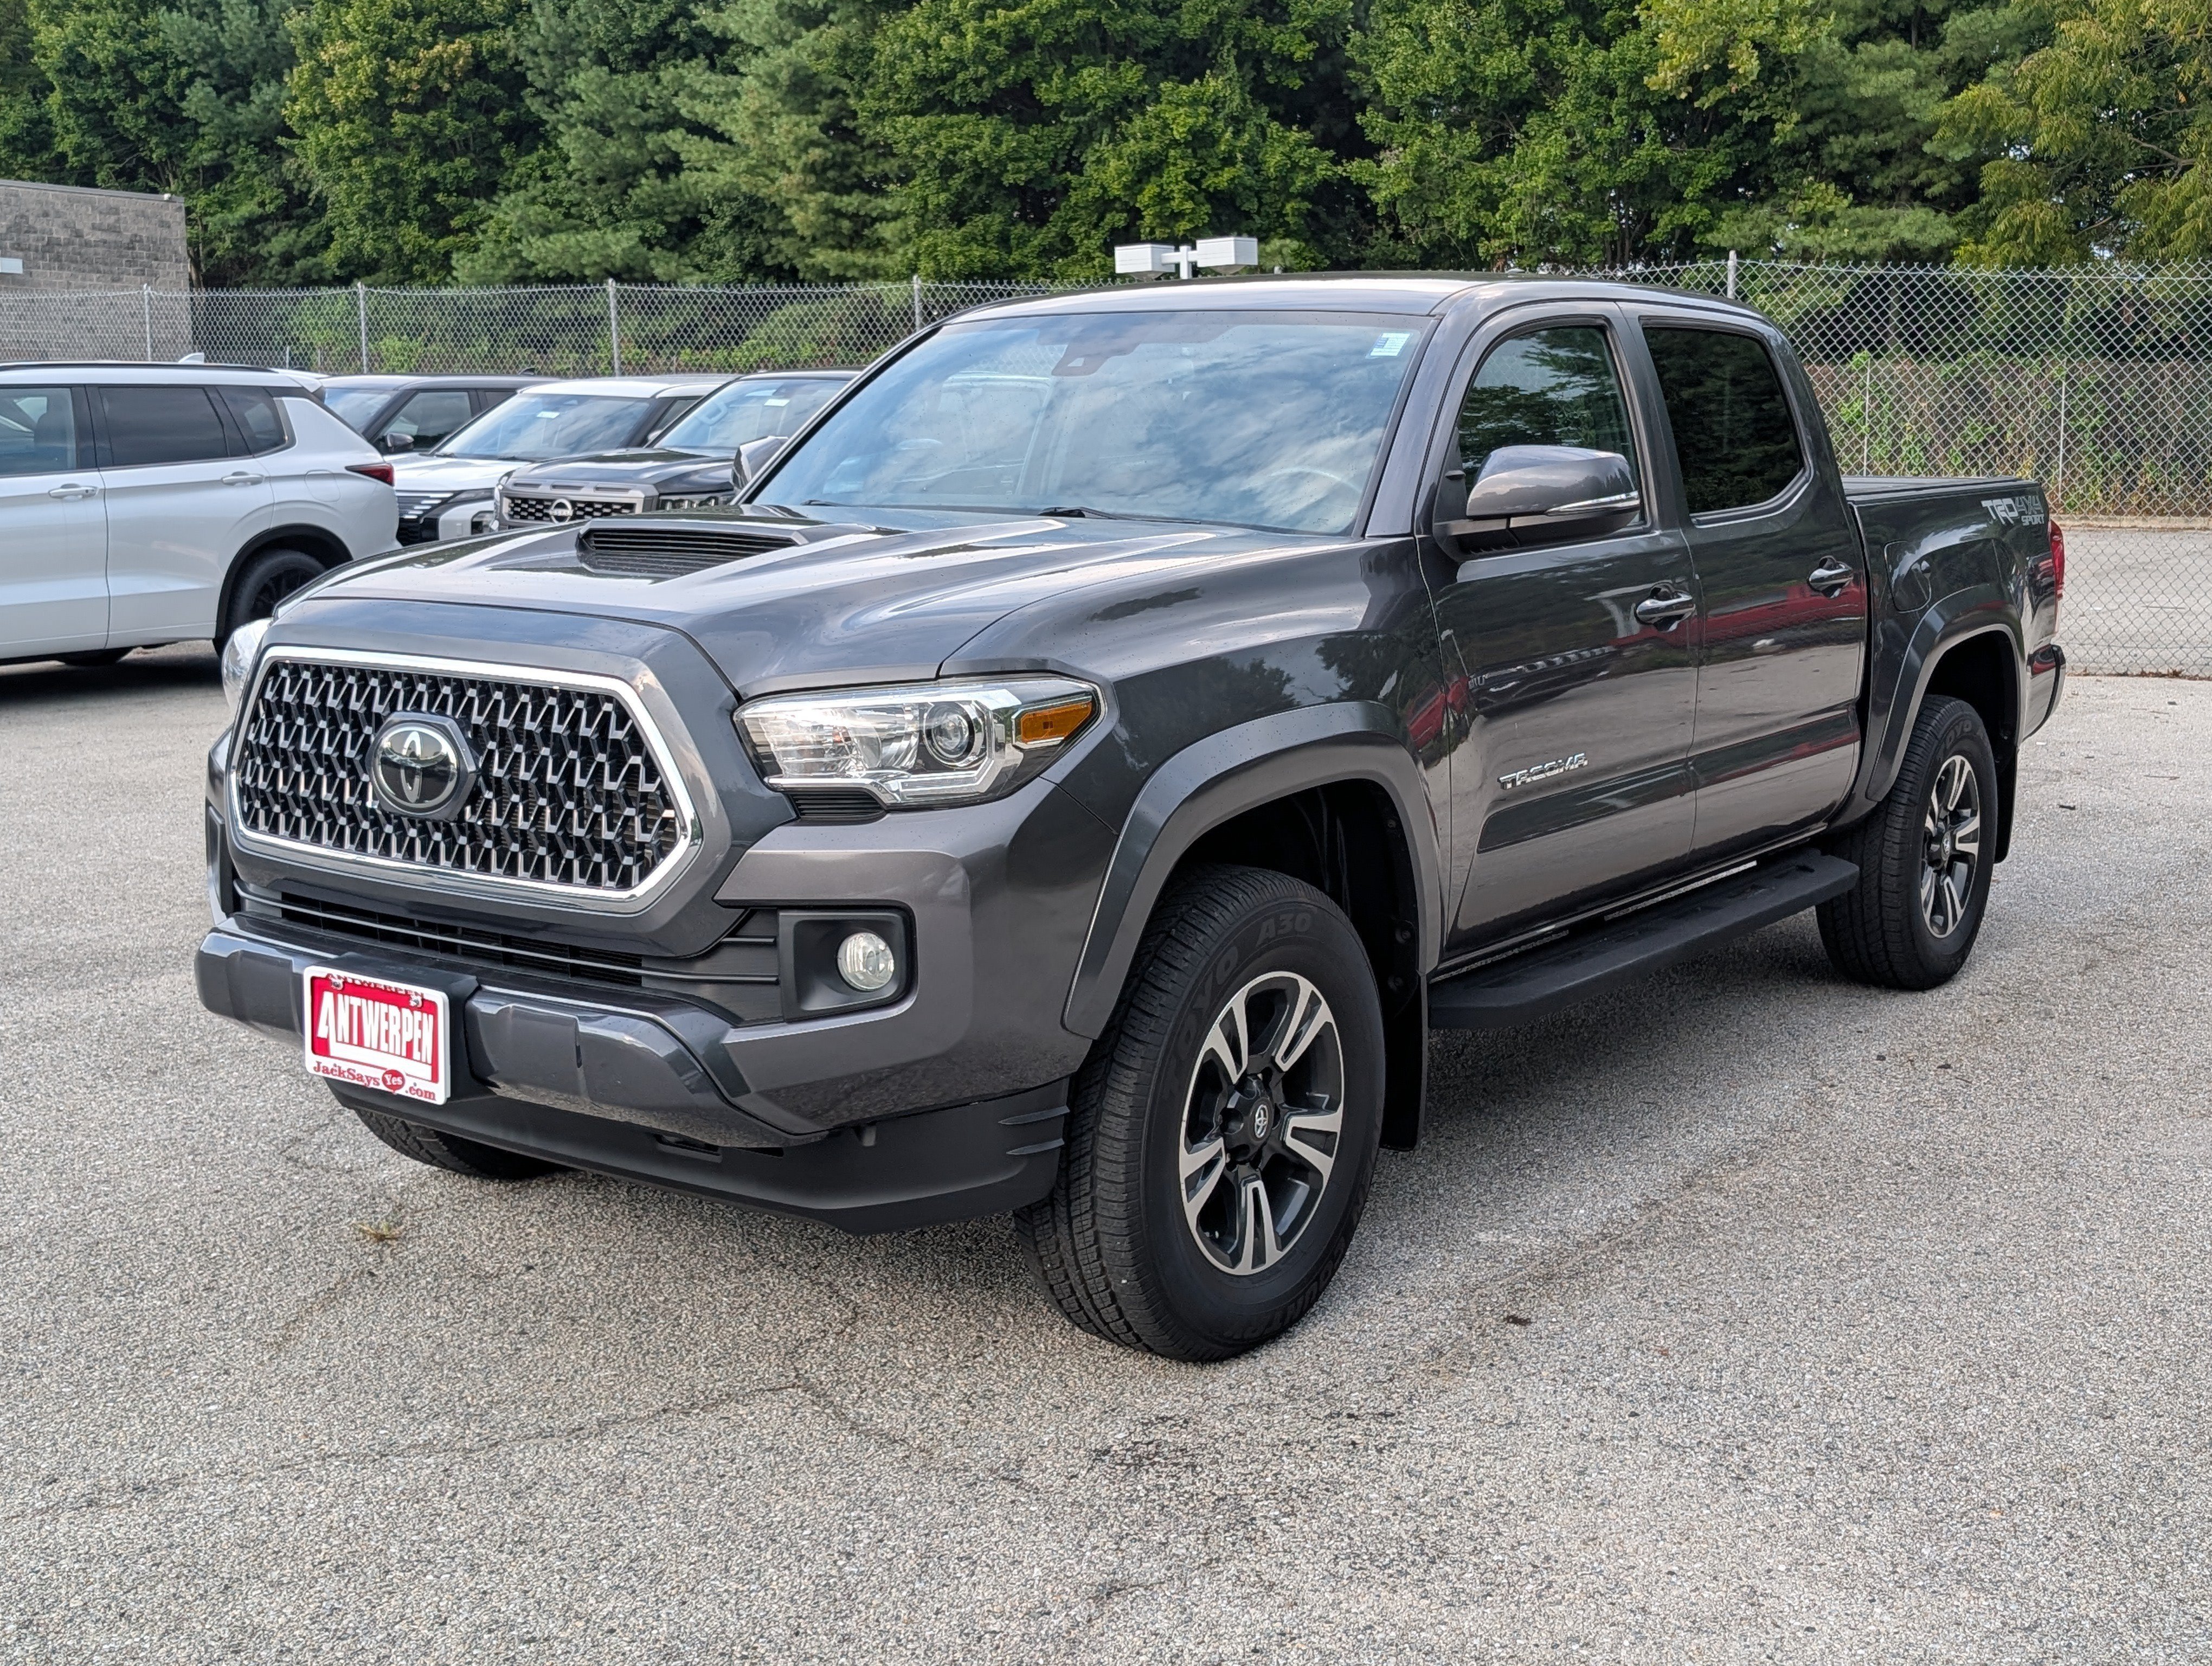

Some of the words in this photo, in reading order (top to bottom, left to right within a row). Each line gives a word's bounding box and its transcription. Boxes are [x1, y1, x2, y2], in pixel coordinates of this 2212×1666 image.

[1980, 498, 2019, 524] TRD
[2021, 514, 2045, 526] SPORT
[1497, 753, 1588, 790] TACOMA
[1256, 913, 1314, 947] A30
[317, 991, 434, 1064] ANTWERPEN
